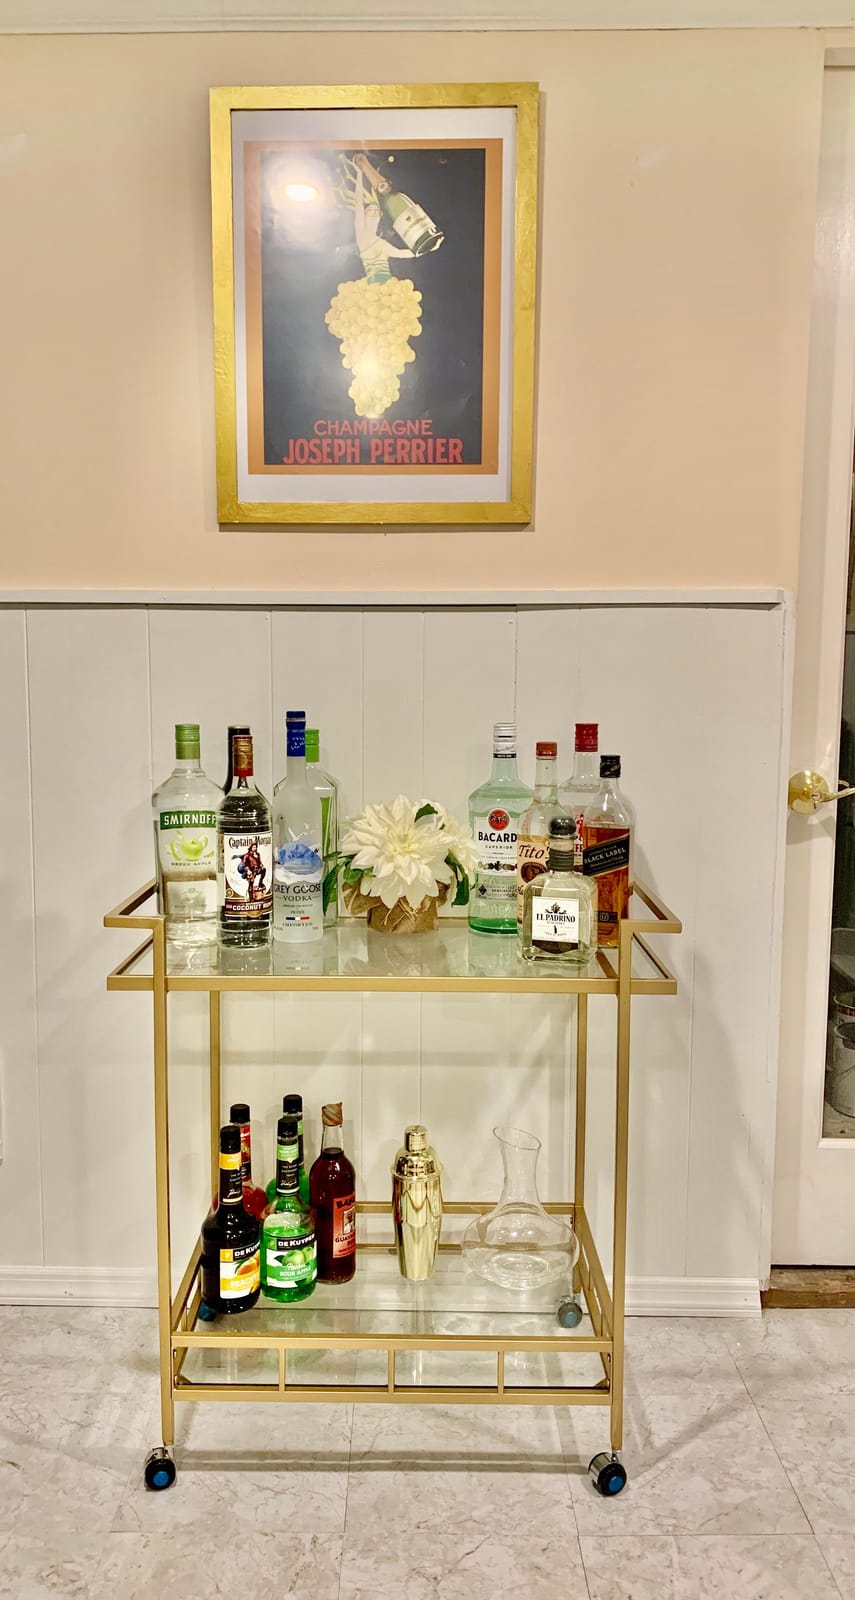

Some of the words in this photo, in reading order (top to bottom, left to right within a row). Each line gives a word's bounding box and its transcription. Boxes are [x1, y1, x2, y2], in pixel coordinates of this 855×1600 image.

[313, 419, 433, 436] CHAMPAGNE
[282, 438, 360, 464] JOSEPH
[370, 438, 464, 464] PERRIER
[228, 836, 253, 849] Captain
[478, 832, 518, 842] BACARD
[584, 854, 604, 865] BLACK
[605, 847, 627, 858] LABEL
[232, 903, 262, 911] COCONUT
[536, 913, 545, 921] EL
[545, 914, 576, 923] PADRINO
